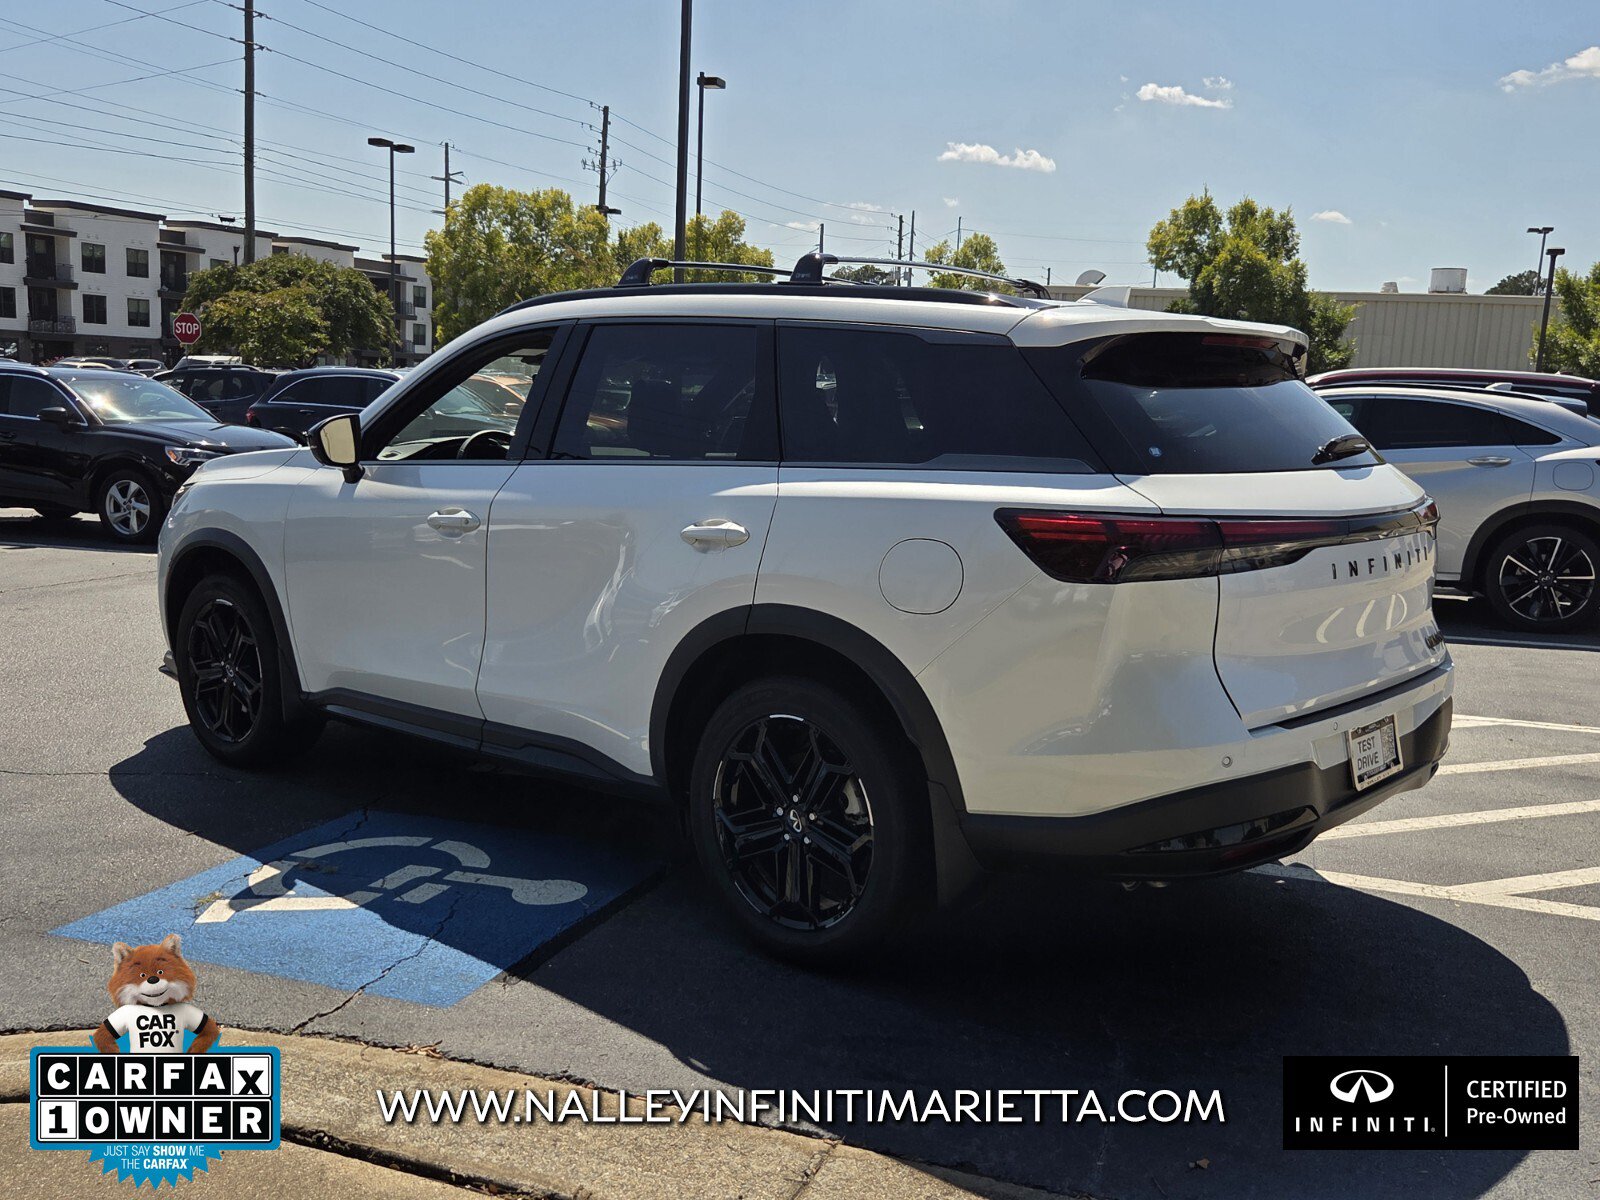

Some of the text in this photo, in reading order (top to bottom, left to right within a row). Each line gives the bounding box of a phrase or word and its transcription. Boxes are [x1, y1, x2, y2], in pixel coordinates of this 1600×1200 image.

[175, 322, 200, 335] STOP
[1331, 546, 1428, 580] INFINITI
[1357, 736, 1375, 754] TEST
[1357, 751, 1380, 771] DRIVE
